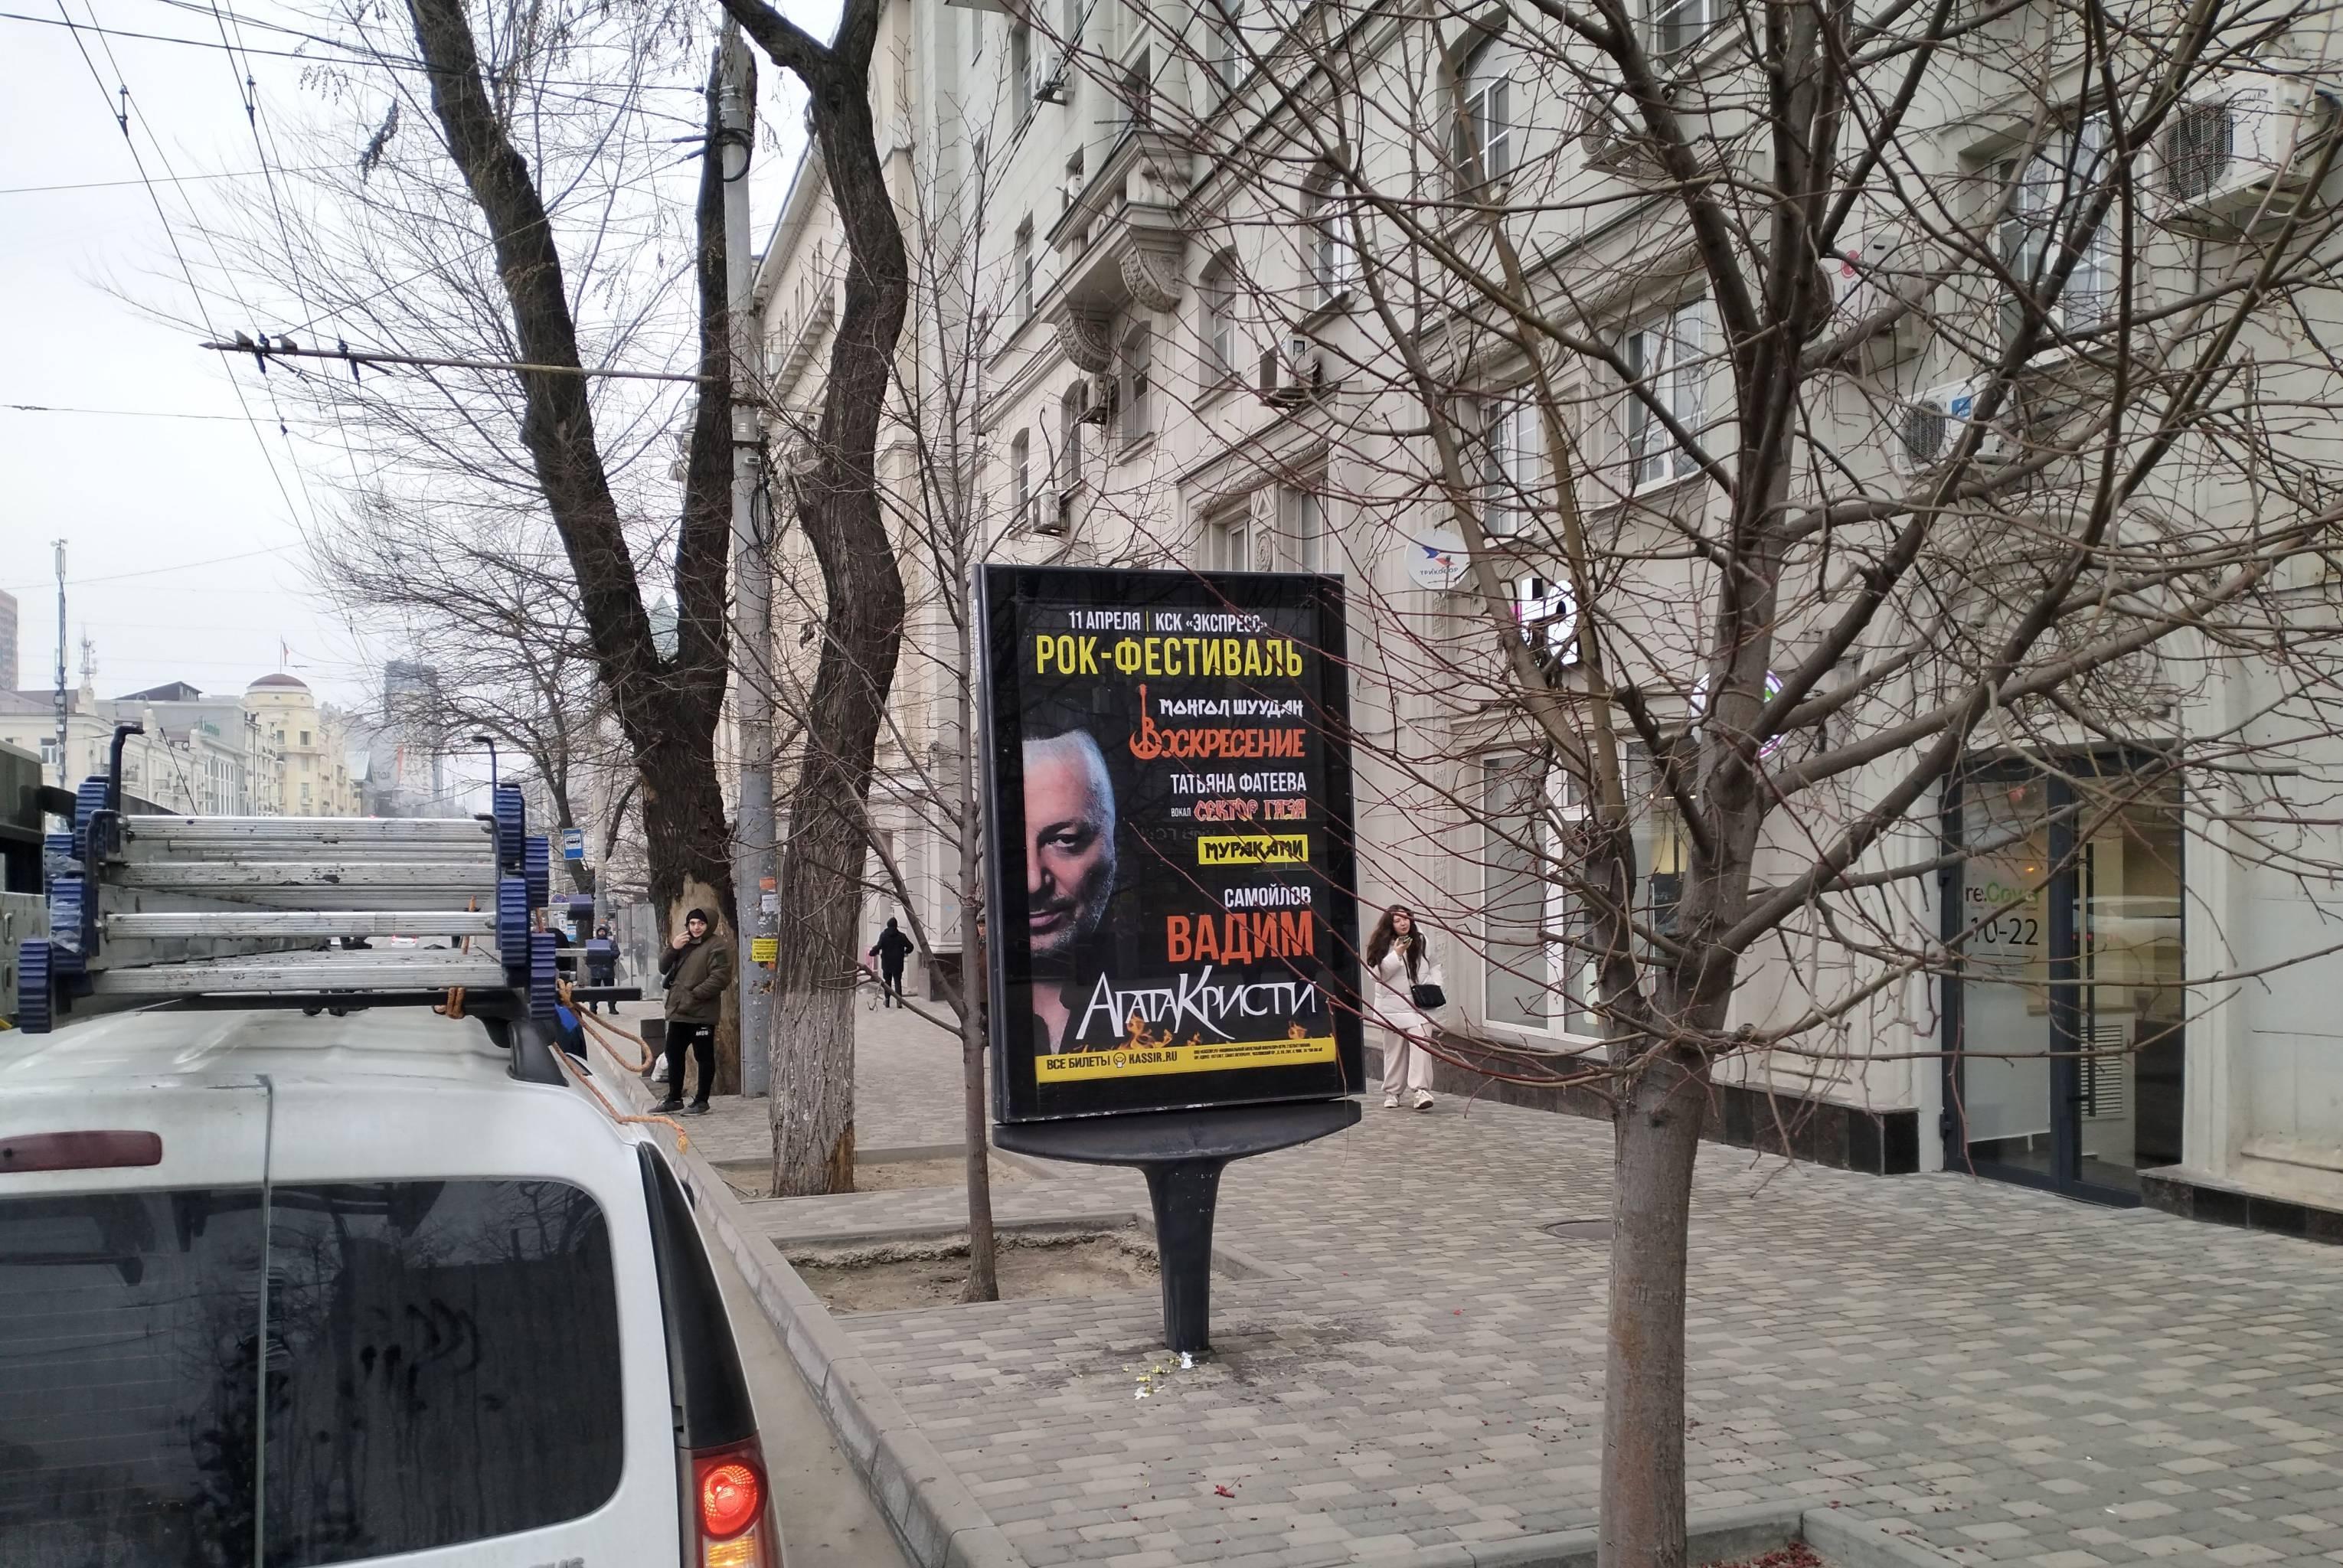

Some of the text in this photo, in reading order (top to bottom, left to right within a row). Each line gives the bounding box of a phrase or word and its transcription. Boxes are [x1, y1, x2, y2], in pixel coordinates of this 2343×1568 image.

[1068, 610, 1082, 629] 11
[1086, 611, 1141, 630] АПРЕЛЯ
[1155, 613, 1182, 632] КСК
[1036, 635, 1302, 677] РОК-ФЕСТИВАЛЬ
[1129, 715, 1306, 760] ВОСКРЕСЕНИЕ
[1170, 772, 1307, 794] ТАТЬЯНА ФАТЕЕВА
[1171, 807, 1191, 817] ВОКАЛ
[1263, 799, 1307, 820] ГАЗА
[1204, 840, 1304, 861] МУРАКАМИ
[1224, 884, 1312, 908] САМОЙЛОВ
[1966, 882, 2040, 903] re.Covr
[1167, 910, 1314, 965] ВАДИМ
[1971, 916, 2038, 946] 10-22
[1047, 1051, 1178, 1070] ВСЕ БИЛЕТЫ KASSIR.RU
